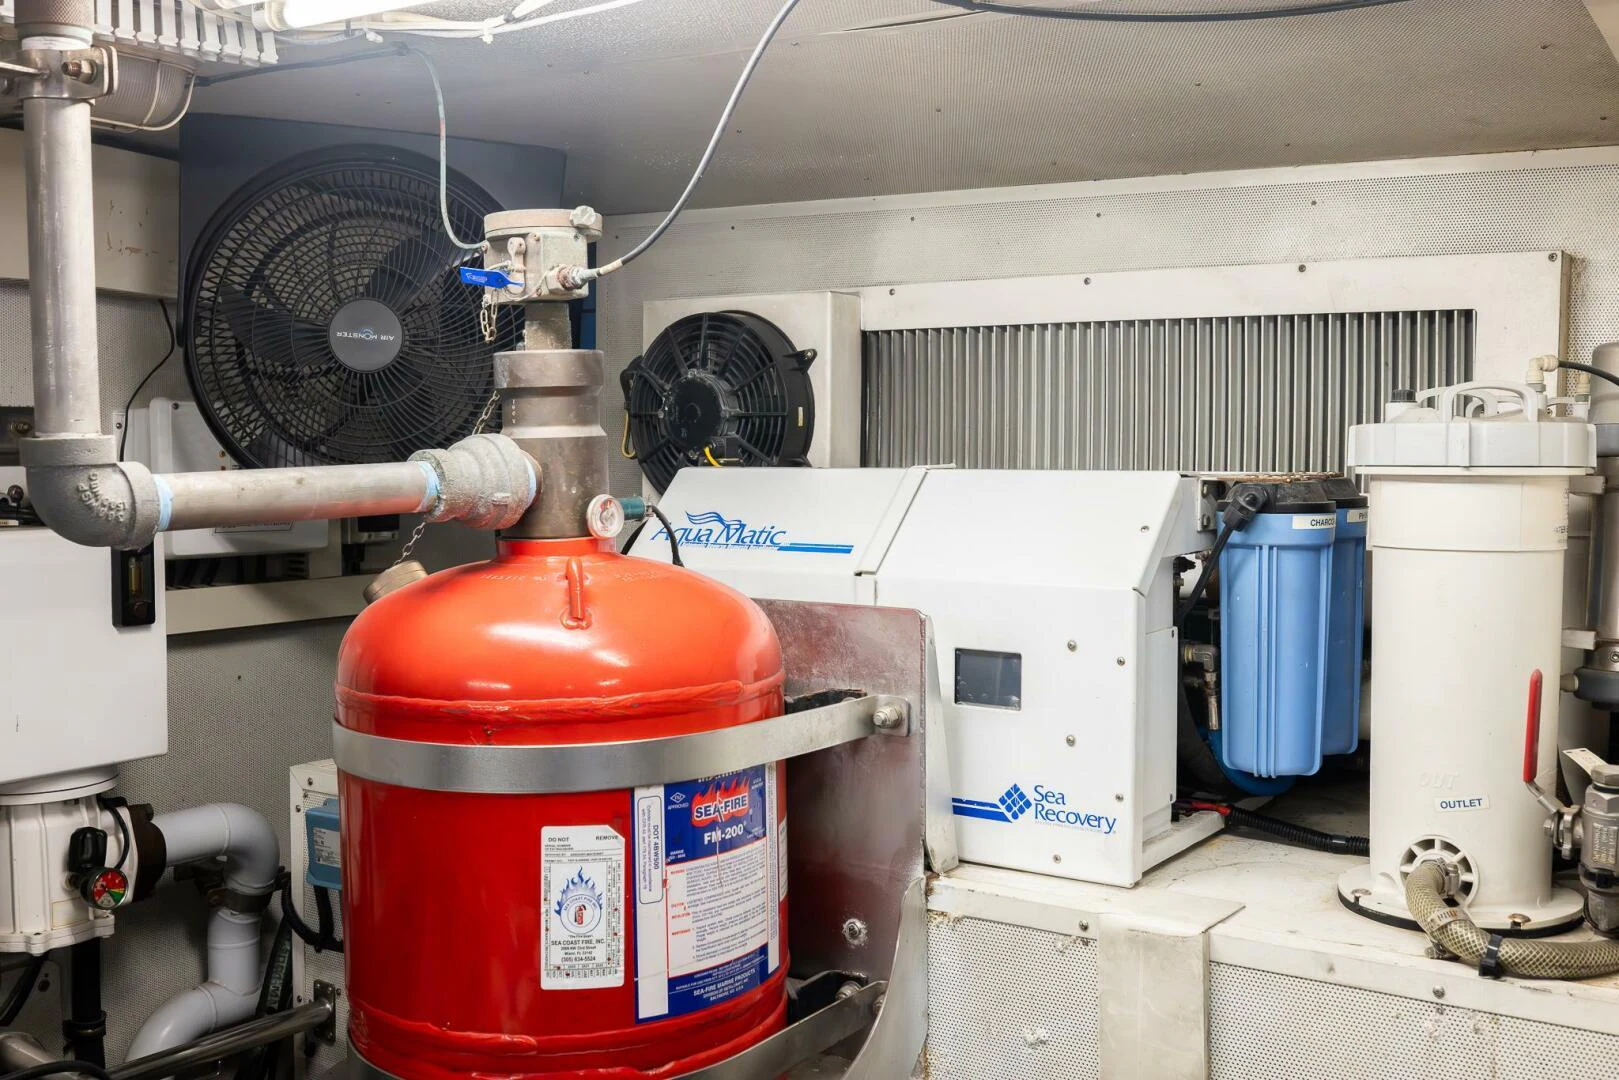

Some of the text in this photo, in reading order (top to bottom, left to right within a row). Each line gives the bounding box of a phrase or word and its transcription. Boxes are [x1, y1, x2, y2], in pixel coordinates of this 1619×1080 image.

[336, 331, 377, 340] MONSTER
[650, 522, 787, 546] Aqua Matic
[1418, 771, 1460, 790] OUT
[695, 793, 748, 819] SEA-FIRE
[1033, 784, 1066, 806] Sea
[1440, 798, 1483, 810] OUTLET
[1034, 802, 1117, 835] Recovery
[704, 823, 744, 845] FM-200
[693, 984, 717, 996] SEA-FIRE
